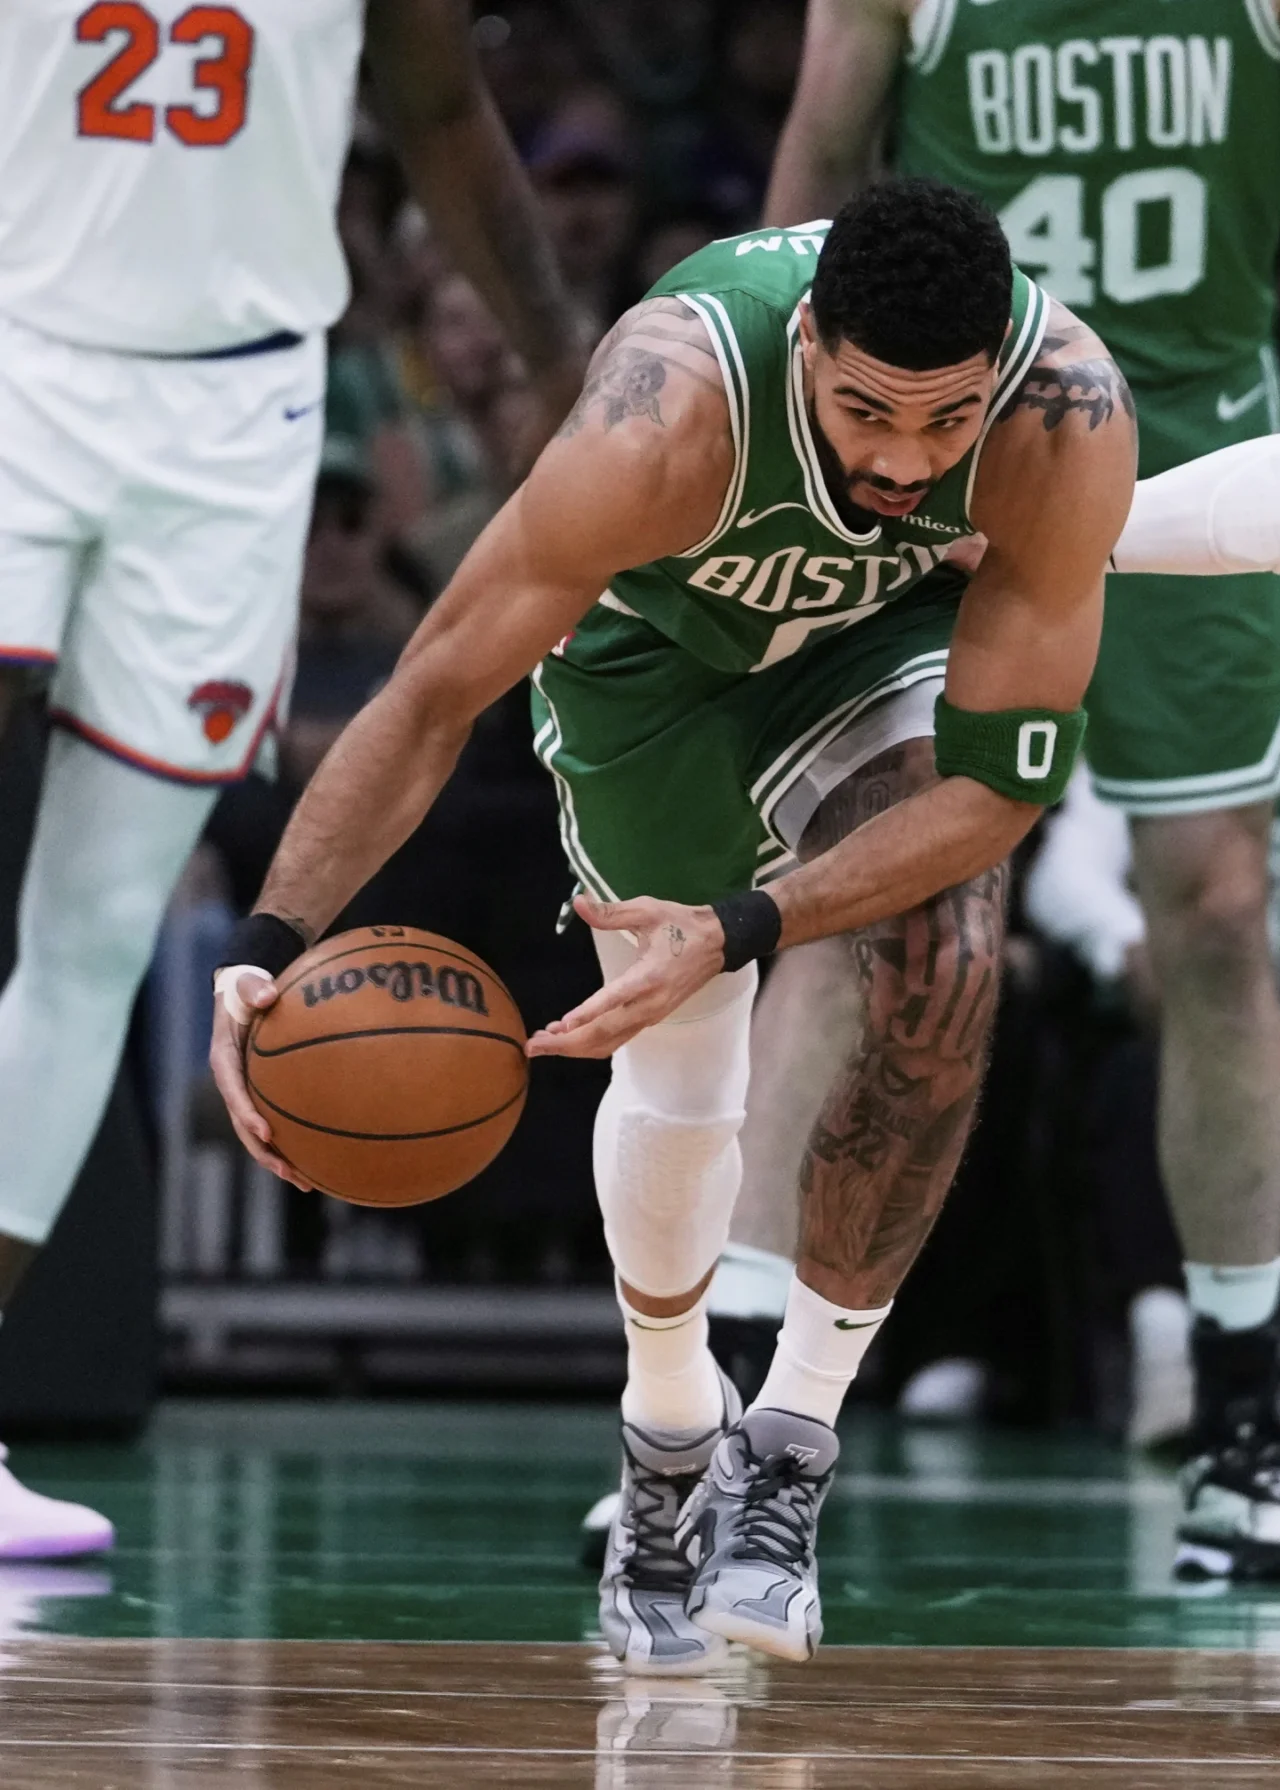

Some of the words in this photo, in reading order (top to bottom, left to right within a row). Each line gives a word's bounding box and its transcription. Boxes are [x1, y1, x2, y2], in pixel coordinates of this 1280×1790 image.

[76, 0, 255, 147] 23
[967, 34, 1232, 156] BOSTON
[998, 167, 1207, 306] 40
[902, 513, 961, 534] mica
[687, 541, 951, 612] BOSTO
[1017, 720, 1058, 779] 0
[302, 960, 489, 1017] Wilson
